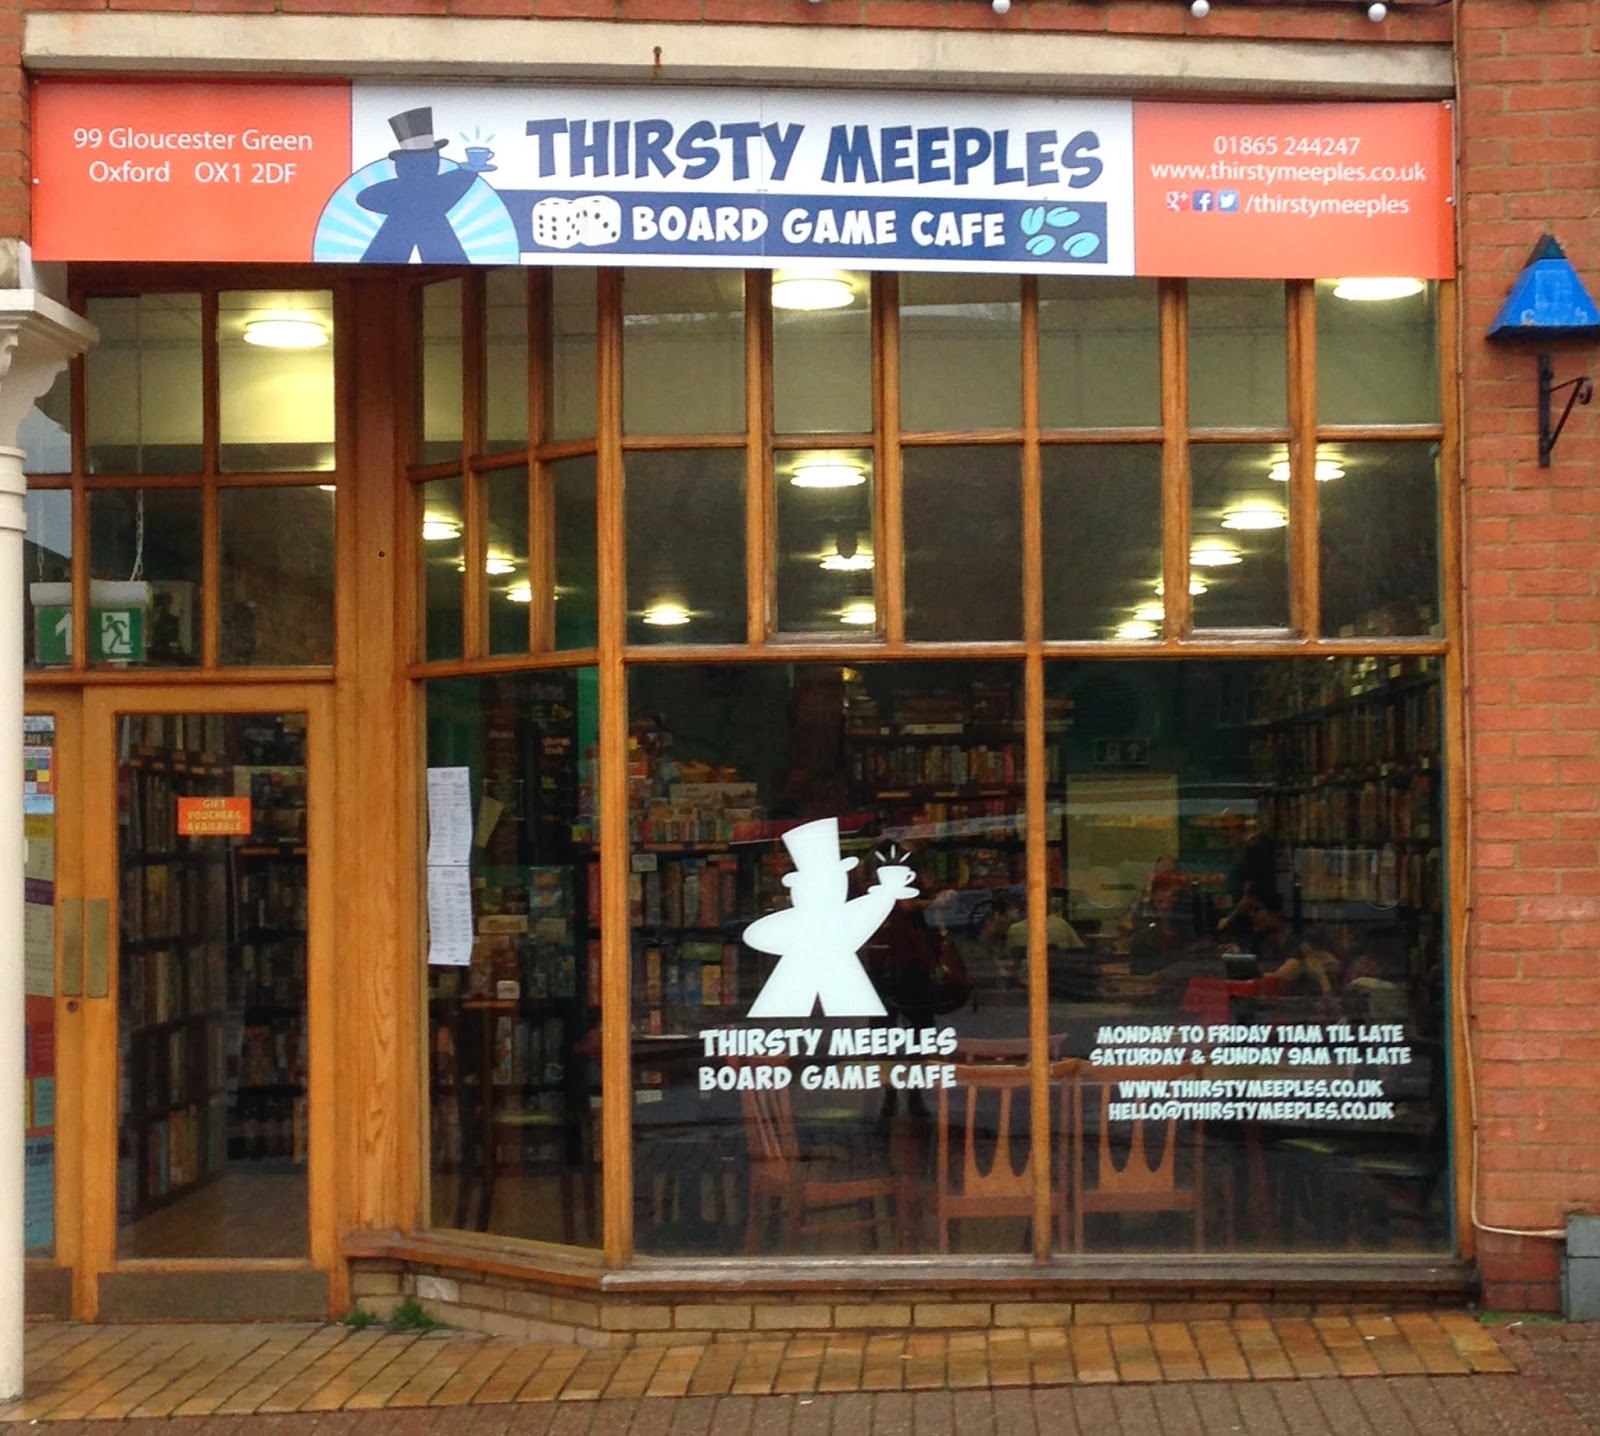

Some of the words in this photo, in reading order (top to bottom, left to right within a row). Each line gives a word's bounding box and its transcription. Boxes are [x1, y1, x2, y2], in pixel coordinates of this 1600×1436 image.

[73, 128, 103, 149] 99
[108, 128, 236, 151] Gloucester
[241, 129, 313, 151] Green
[1213, 135, 1278, 155] 01865
[1284, 136, 1361, 156] 244247
[525, 117, 805, 181] THIRSTY
[820, 124, 1104, 188] MEEPLES
[88, 161, 171, 183] Oxford
[194, 162, 242, 184] OX1
[250, 163, 297, 185] 2DF
[1150, 160, 1427, 185] www.thirstymeeples.co.uk
[1245, 194, 1410, 218] /thirstymeeples
[632, 205, 768, 242] BOARD
[782, 209, 897, 245] GAME
[911, 212, 1005, 248] CAFE
[203, 799, 226, 808] GIFT
[187, 822, 242, 832] AVAILABLE
[700, 1028, 823, 1057] THIRSTY
[828, 1027, 958, 1056] MEEPLES
[1096, 1025, 1175, 1044] MONDAY
[1178, 1026, 1203, 1043] TO
[1207, 1025, 1270, 1044] FRIDAY
[1276, 1025, 1322, 1043] 11AM
[1326, 1025, 1355, 1043] TIL
[1358, 1025, 1404, 1043] LATE
[1089, 1047, 1186, 1066] SATURDAY
[1190, 1049, 1205, 1064] &
[1209, 1047, 1283, 1065] SUNDAY
[1288, 1047, 1330, 1065] 9AM
[1334, 1047, 1362, 1065] TIL
[1366, 1047, 1412, 1065] LATE
[699, 1065, 792, 1091] BOARD
[801, 1065, 881, 1090] GAME
[890, 1065, 957, 1090] CAFE
[1118, 1079, 1384, 1099] WWW.THIRSTYMEEPLES.CO.UK
[1107, 1101, 1395, 1121] HELLO@THIRSTYMEEPLES.CO.UK
